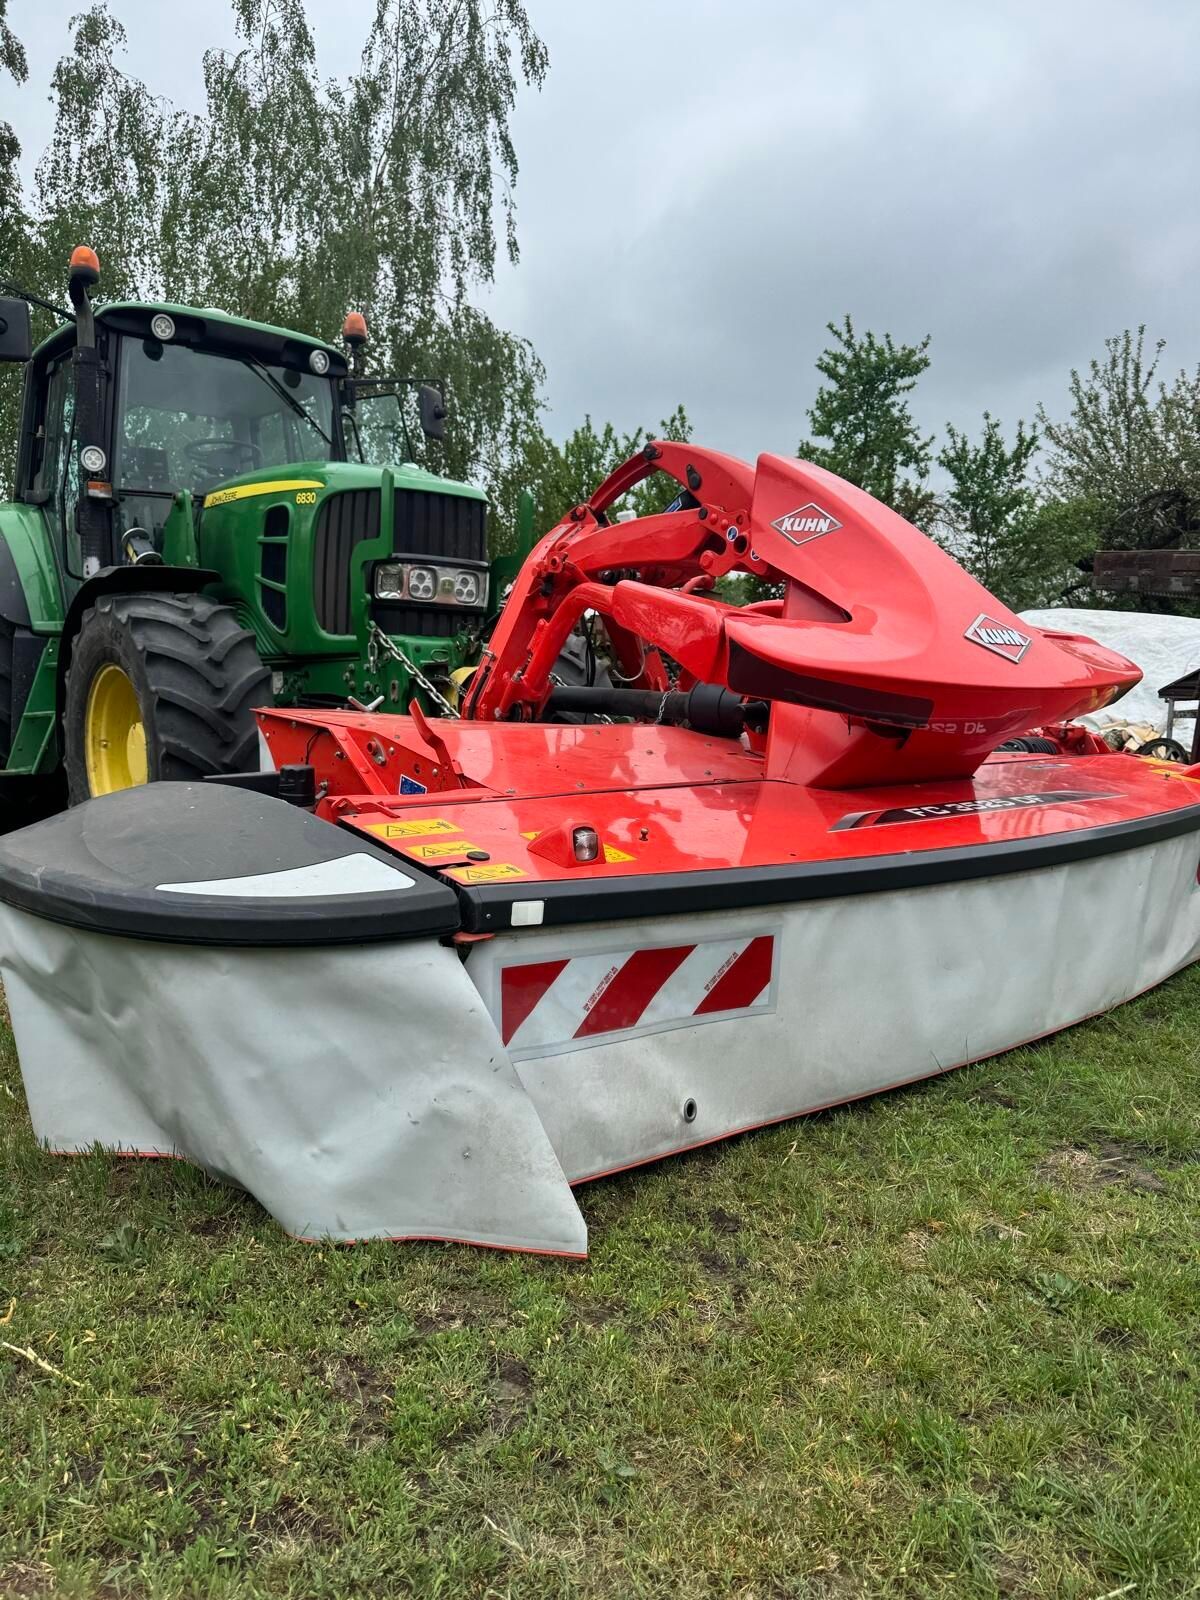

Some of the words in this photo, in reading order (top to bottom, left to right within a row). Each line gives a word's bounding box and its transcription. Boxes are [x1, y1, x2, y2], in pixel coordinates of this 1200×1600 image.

[295, 491, 317, 505] 6830
[781, 517, 831, 532] KUHN
[974, 627, 1028, 646] KUHN
[903, 805, 951, 817] FC
[944, 798, 1016, 812] 3525
[1010, 794, 1045, 804] DF
